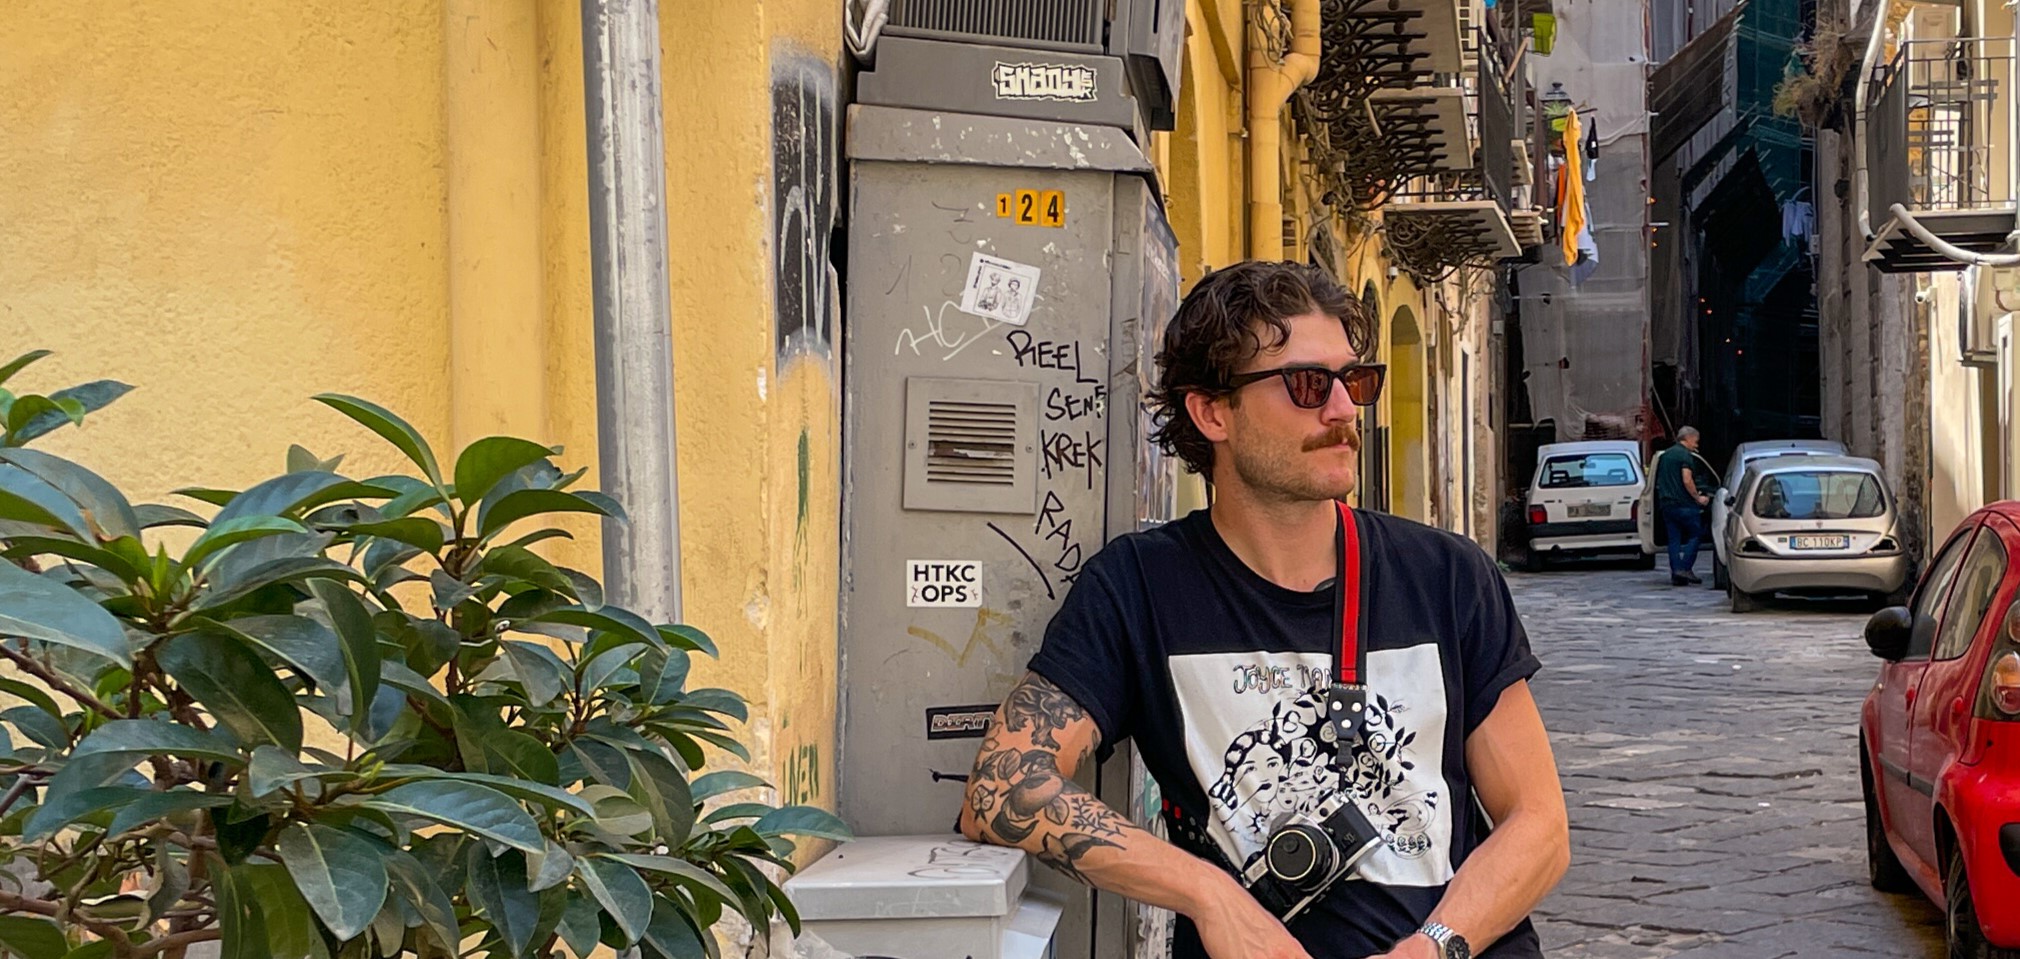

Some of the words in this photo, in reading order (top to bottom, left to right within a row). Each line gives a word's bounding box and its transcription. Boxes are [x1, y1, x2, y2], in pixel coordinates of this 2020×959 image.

[999, 192, 1060, 224] 124
[1006, 329, 1099, 383] REEL
[1040, 429, 1103, 490] KREK
[914, 564, 976, 582] HTKC
[921, 584, 968, 603] OPS
[1233, 663, 1294, 694] JOYCE
